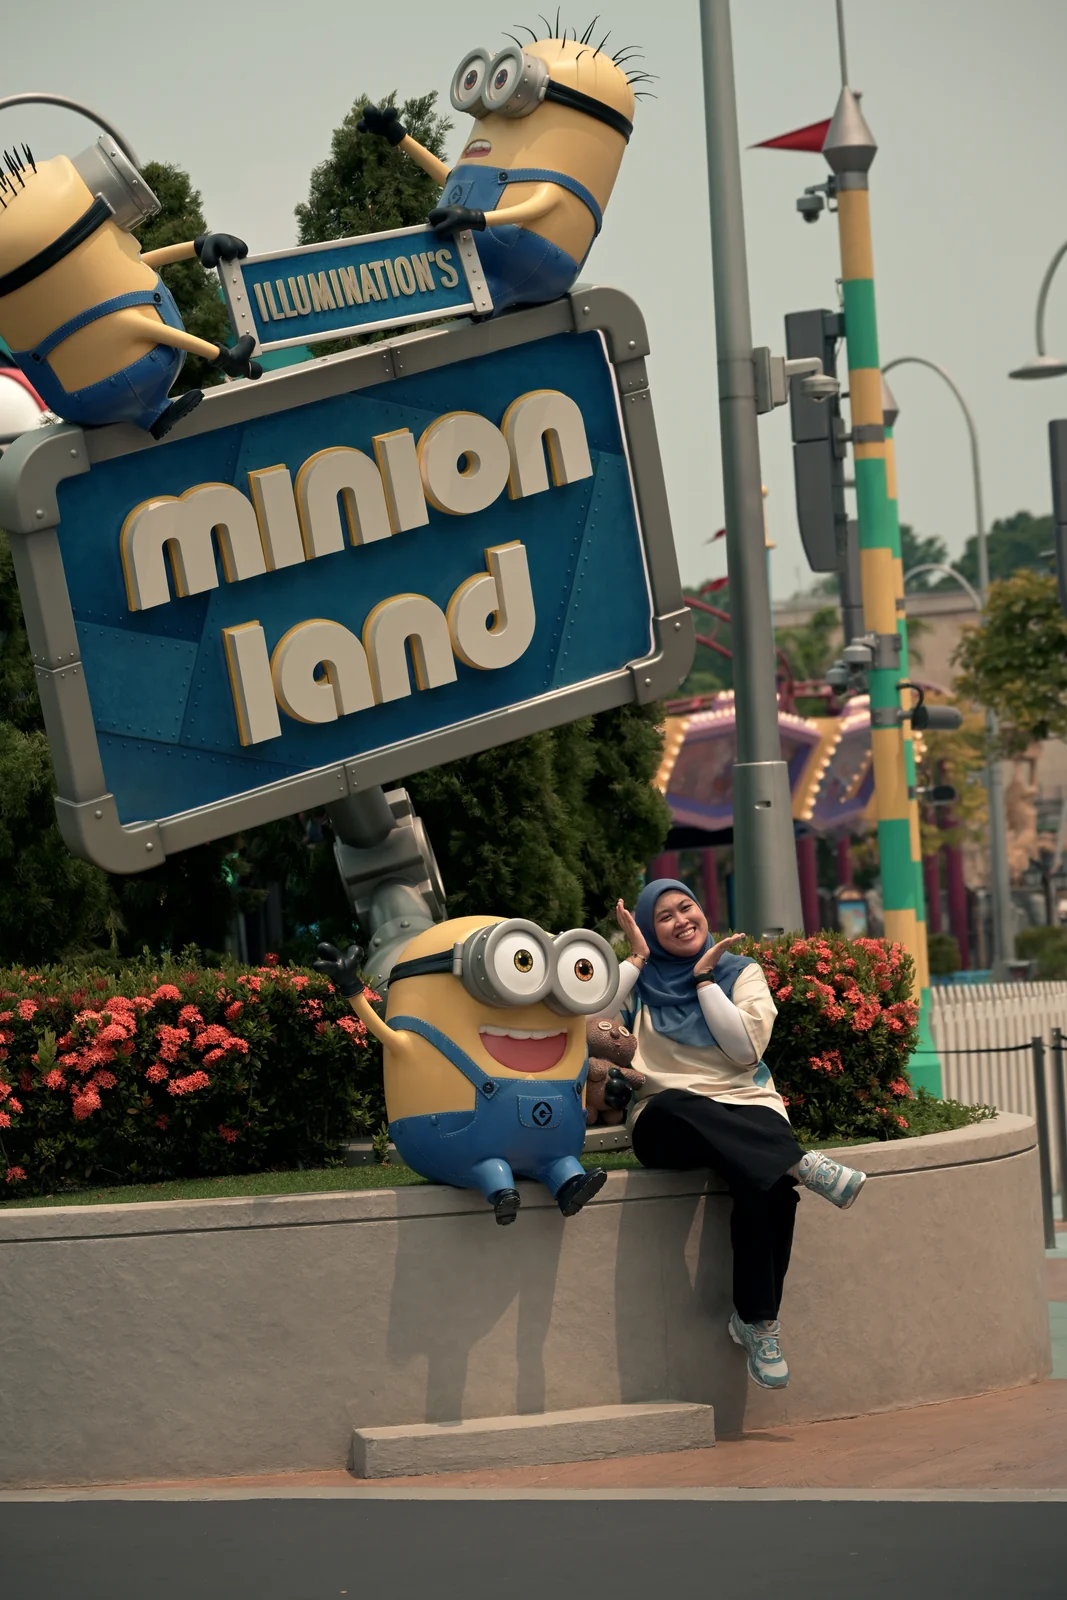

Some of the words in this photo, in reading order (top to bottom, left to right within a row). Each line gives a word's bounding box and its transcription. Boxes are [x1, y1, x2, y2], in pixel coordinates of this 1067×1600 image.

[253, 249, 459, 323] ILLUMINATION'S
[120, 389, 593, 612] minion
[221, 540, 536, 747] land
